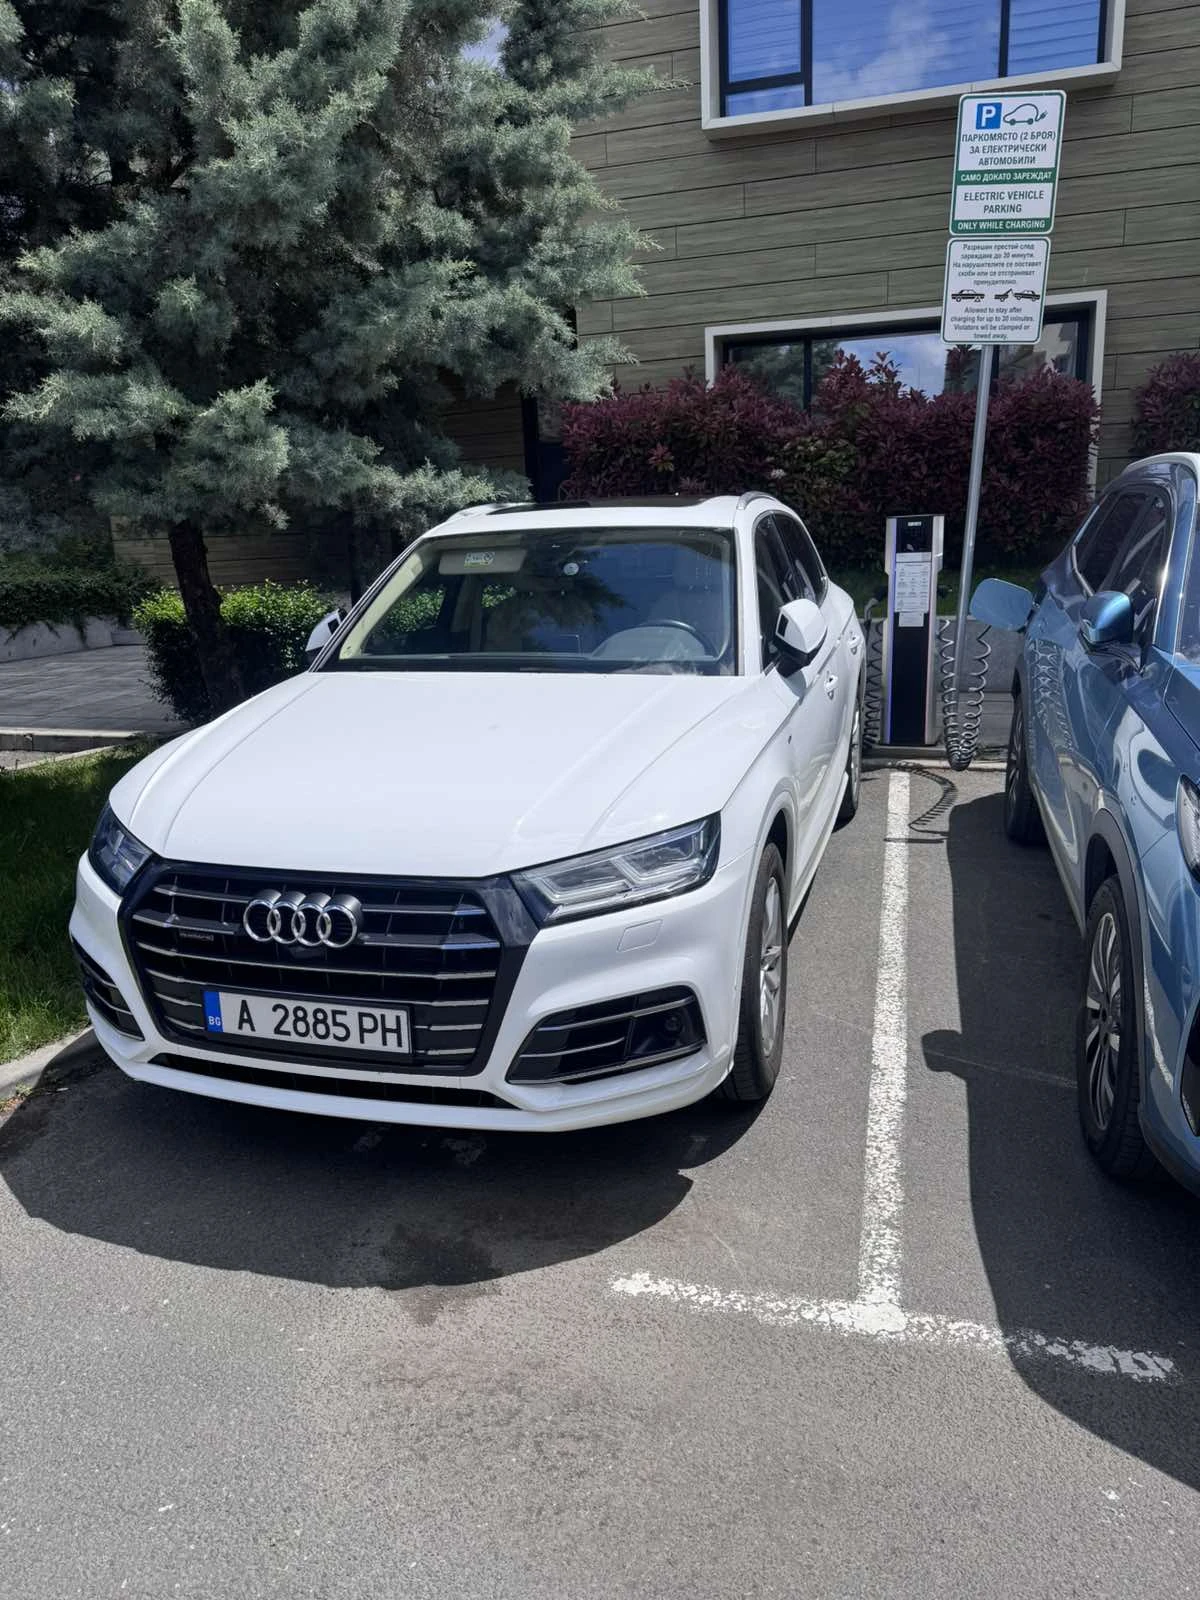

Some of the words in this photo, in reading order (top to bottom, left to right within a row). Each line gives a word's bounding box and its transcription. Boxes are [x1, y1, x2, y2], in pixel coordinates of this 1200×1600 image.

[981, 105, 996, 127] P
[962, 132, 1018, 142] ПАРКОМЯСТО
[1020, 132, 1029, 142] (2
[1031, 130, 1056, 141] БРОЯ)
[969, 145, 980, 154] ЗА
[982, 143, 1047, 154] ЕЛЕКТРИЧЕСКИ
[978, 156, 1036, 166] АВТОМОБИЛИ
[960, 173, 981, 181] САМО
[982, 172, 1011, 182] ДОКАТО
[1013, 171, 1052, 181] ЗАРЕЖДАТ
[964, 191, 1005, 201] ELECTRIC
[1007, 190, 1045, 200] VEHICLE
[983, 204, 1022, 213] PARKING
[957, 221, 978, 230] ONLY
[979, 221, 1004, 230] WHILE
[1005, 220, 1045, 229] CHARGING
[208, 1015, 222, 1027] BG
[238, 999, 256, 1032] A
[271, 1003, 351, 1042] 2885
